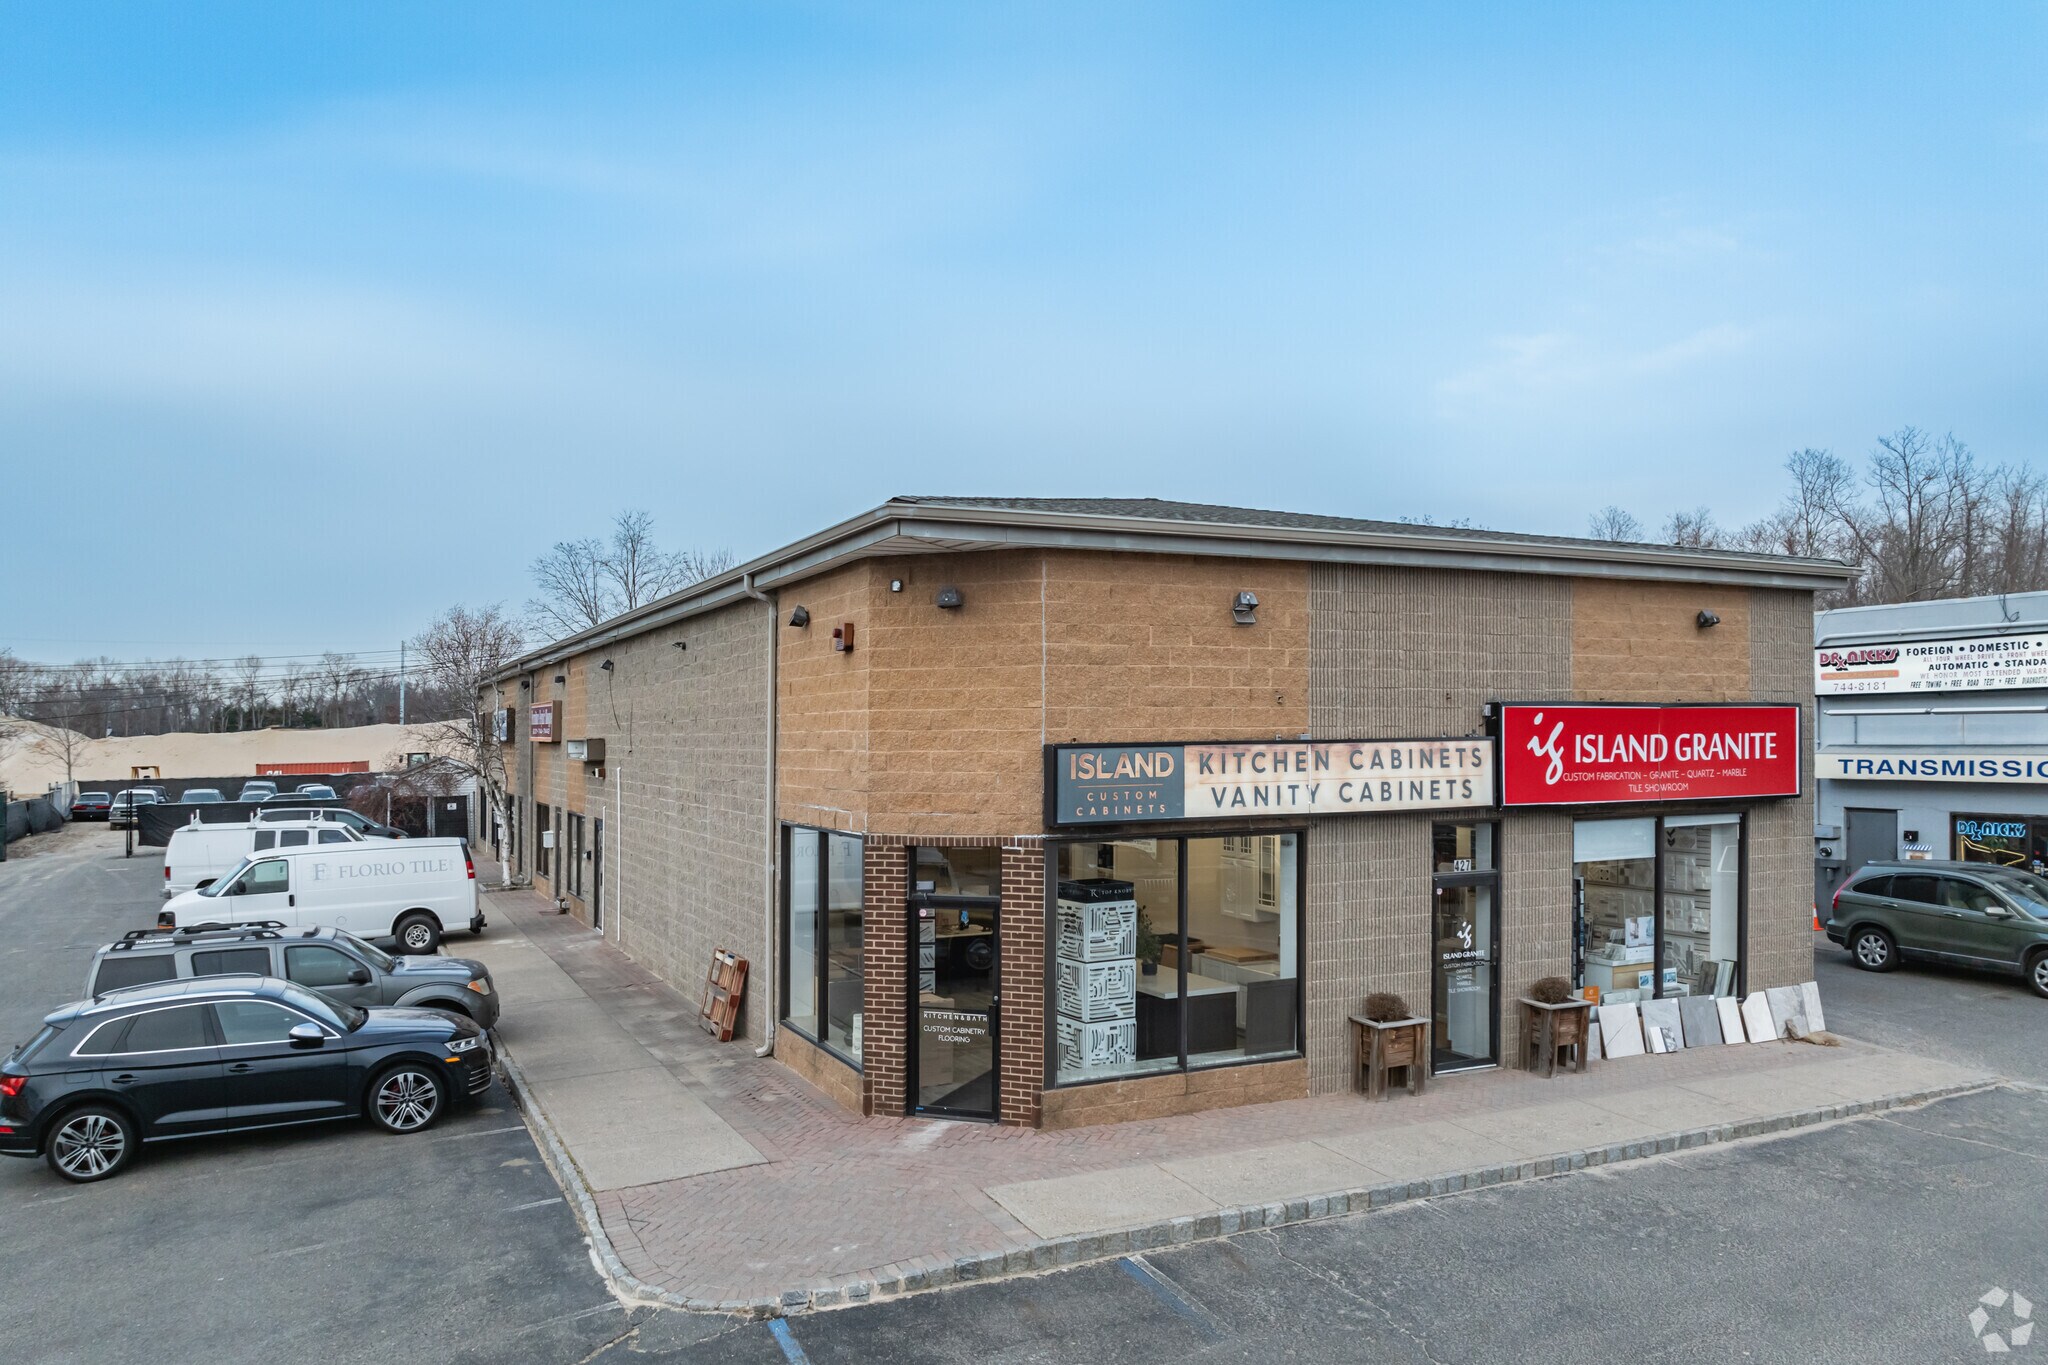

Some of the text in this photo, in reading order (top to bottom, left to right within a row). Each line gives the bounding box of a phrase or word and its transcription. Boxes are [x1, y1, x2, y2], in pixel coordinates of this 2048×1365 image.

[1906, 641, 2030, 656] FOREIGN DOMESTIC
[1847, 648, 1899, 663] NICK'S
[1929, 658, 2048, 671] AUTOMATIC STANDA
[1986, 668, 2021, 676] EXTENDED
[1834, 681, 1887, 691] 744-8181
[1926, 680, 1942, 688] TOWING
[1951, 679, 1962, 687] FREE
[1967, 678, 1980, 687] ROAD
[1984, 678, 1995, 686] TEST
[2005, 677, 2016, 685] FREE
[1575, 732, 1778, 763] ISLAND GRANITE
[1070, 752, 1174, 780] ISLAND
[1199, 747, 1483, 775] KITCHEN CABINETS
[1562, 768, 1748, 782] CUSTOM FABRICATION GRANITE QUARTZ MARBLE
[1211, 779, 1473, 808] VANITY CABINETS
[1628, 783, 1689, 793] TILE SHOWROOM
[1086, 790, 1158, 802] CUSTOM
[1076, 804, 1166, 816] CABINETS
[1982, 822, 2026, 837] NICK'S
[339, 860, 405, 879] FLORIO
[409, 859, 448, 874] TILE
[1455, 860, 1470, 872] 427
[135, 937, 174, 945] PATHFINDER
[1463, 949, 1485, 958] GRANITE
[923, 1025, 986, 1035] CUSTOM CABINETRY
[938, 1034, 971, 1043] FLOORING
